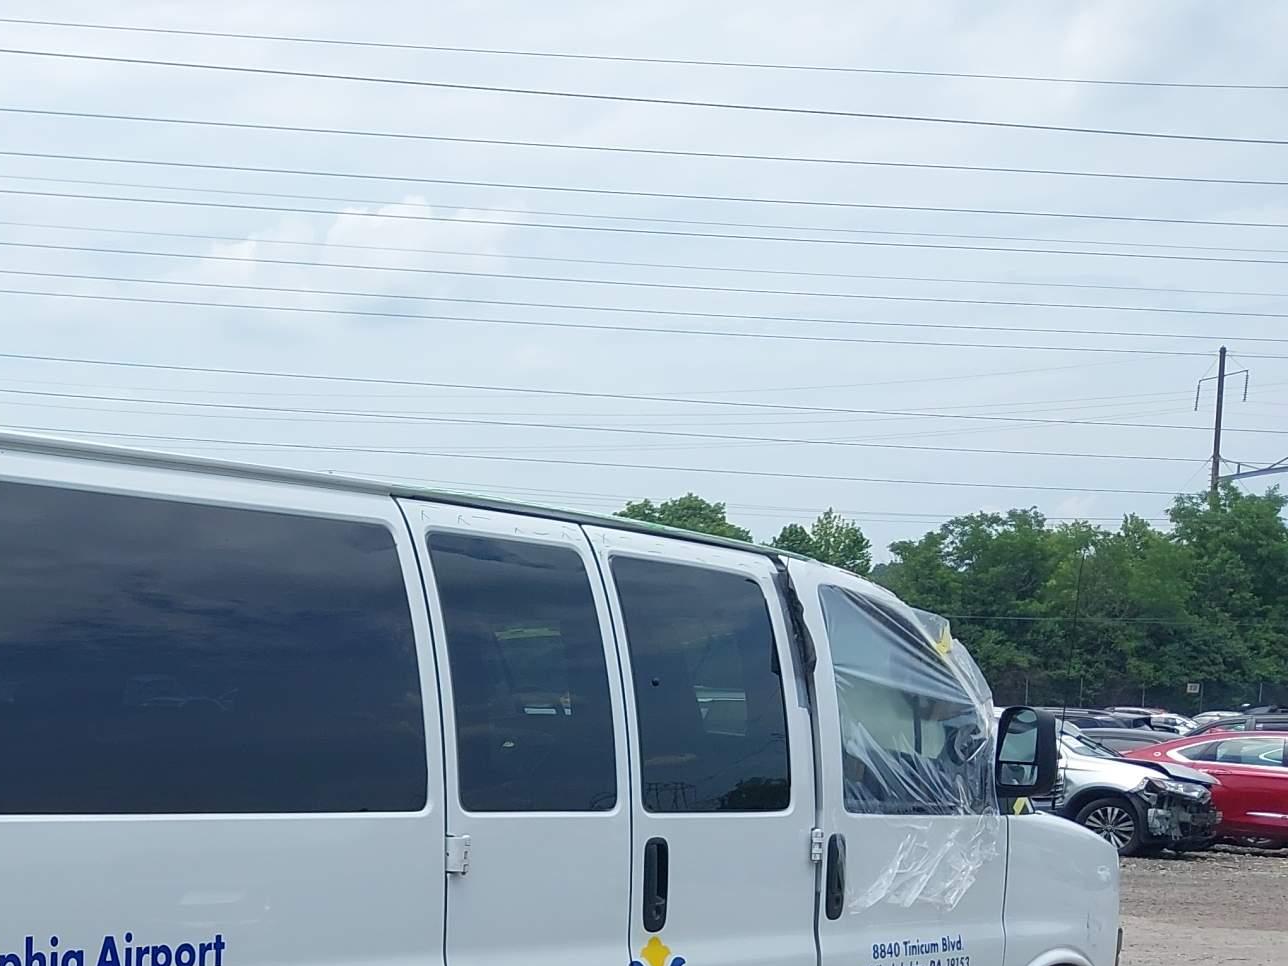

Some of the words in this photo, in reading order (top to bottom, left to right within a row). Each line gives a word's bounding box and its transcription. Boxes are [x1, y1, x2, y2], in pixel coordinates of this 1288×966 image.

[872, 942, 901, 960] 8840
[903, 939, 939, 957] Tinicum
[942, 934, 964, 952] Blvd.
